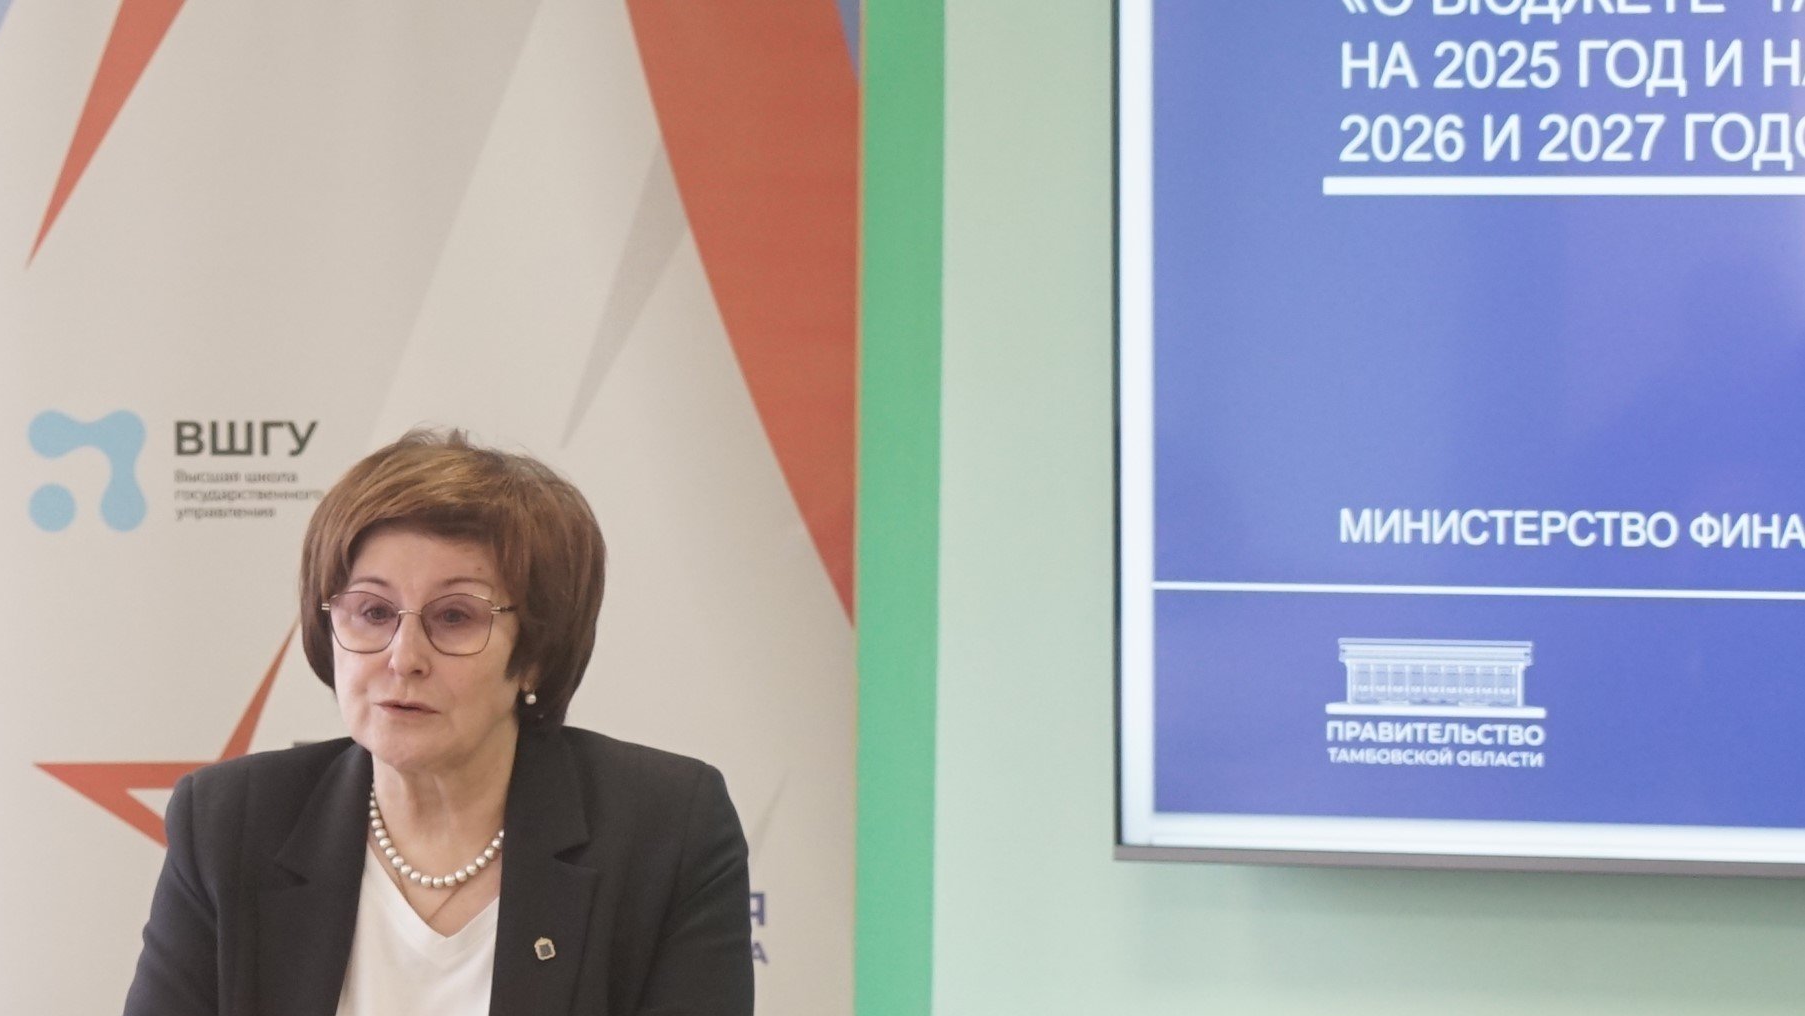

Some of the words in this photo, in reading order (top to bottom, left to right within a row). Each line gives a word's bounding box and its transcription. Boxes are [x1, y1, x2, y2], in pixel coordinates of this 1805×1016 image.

[1341, 41, 1419, 89] НА
[1433, 41, 1560, 89] 2025
[1578, 39, 1687, 97] ГОД
[1705, 38, 1742, 88] И
[1763, 38, 1805, 88] Н
[1339, 114, 1465, 162] 2026
[1483, 114, 1521, 162] И
[1538, 113, 1665, 162] 2027
[1685, 112, 1805, 171] ГОД
[174, 420, 318, 457] ВШГУ
[1339, 508, 1679, 548] МИНИСТЕРСТВО
[1689, 511, 1805, 550] ФИНА
[1326, 720, 1545, 747] ПРАВИТЕЛЬСТВО
[1327, 747, 1453, 766] ТАМБОВСКОЙ
[1456, 751, 1545, 768] ОБЛАСТИ
